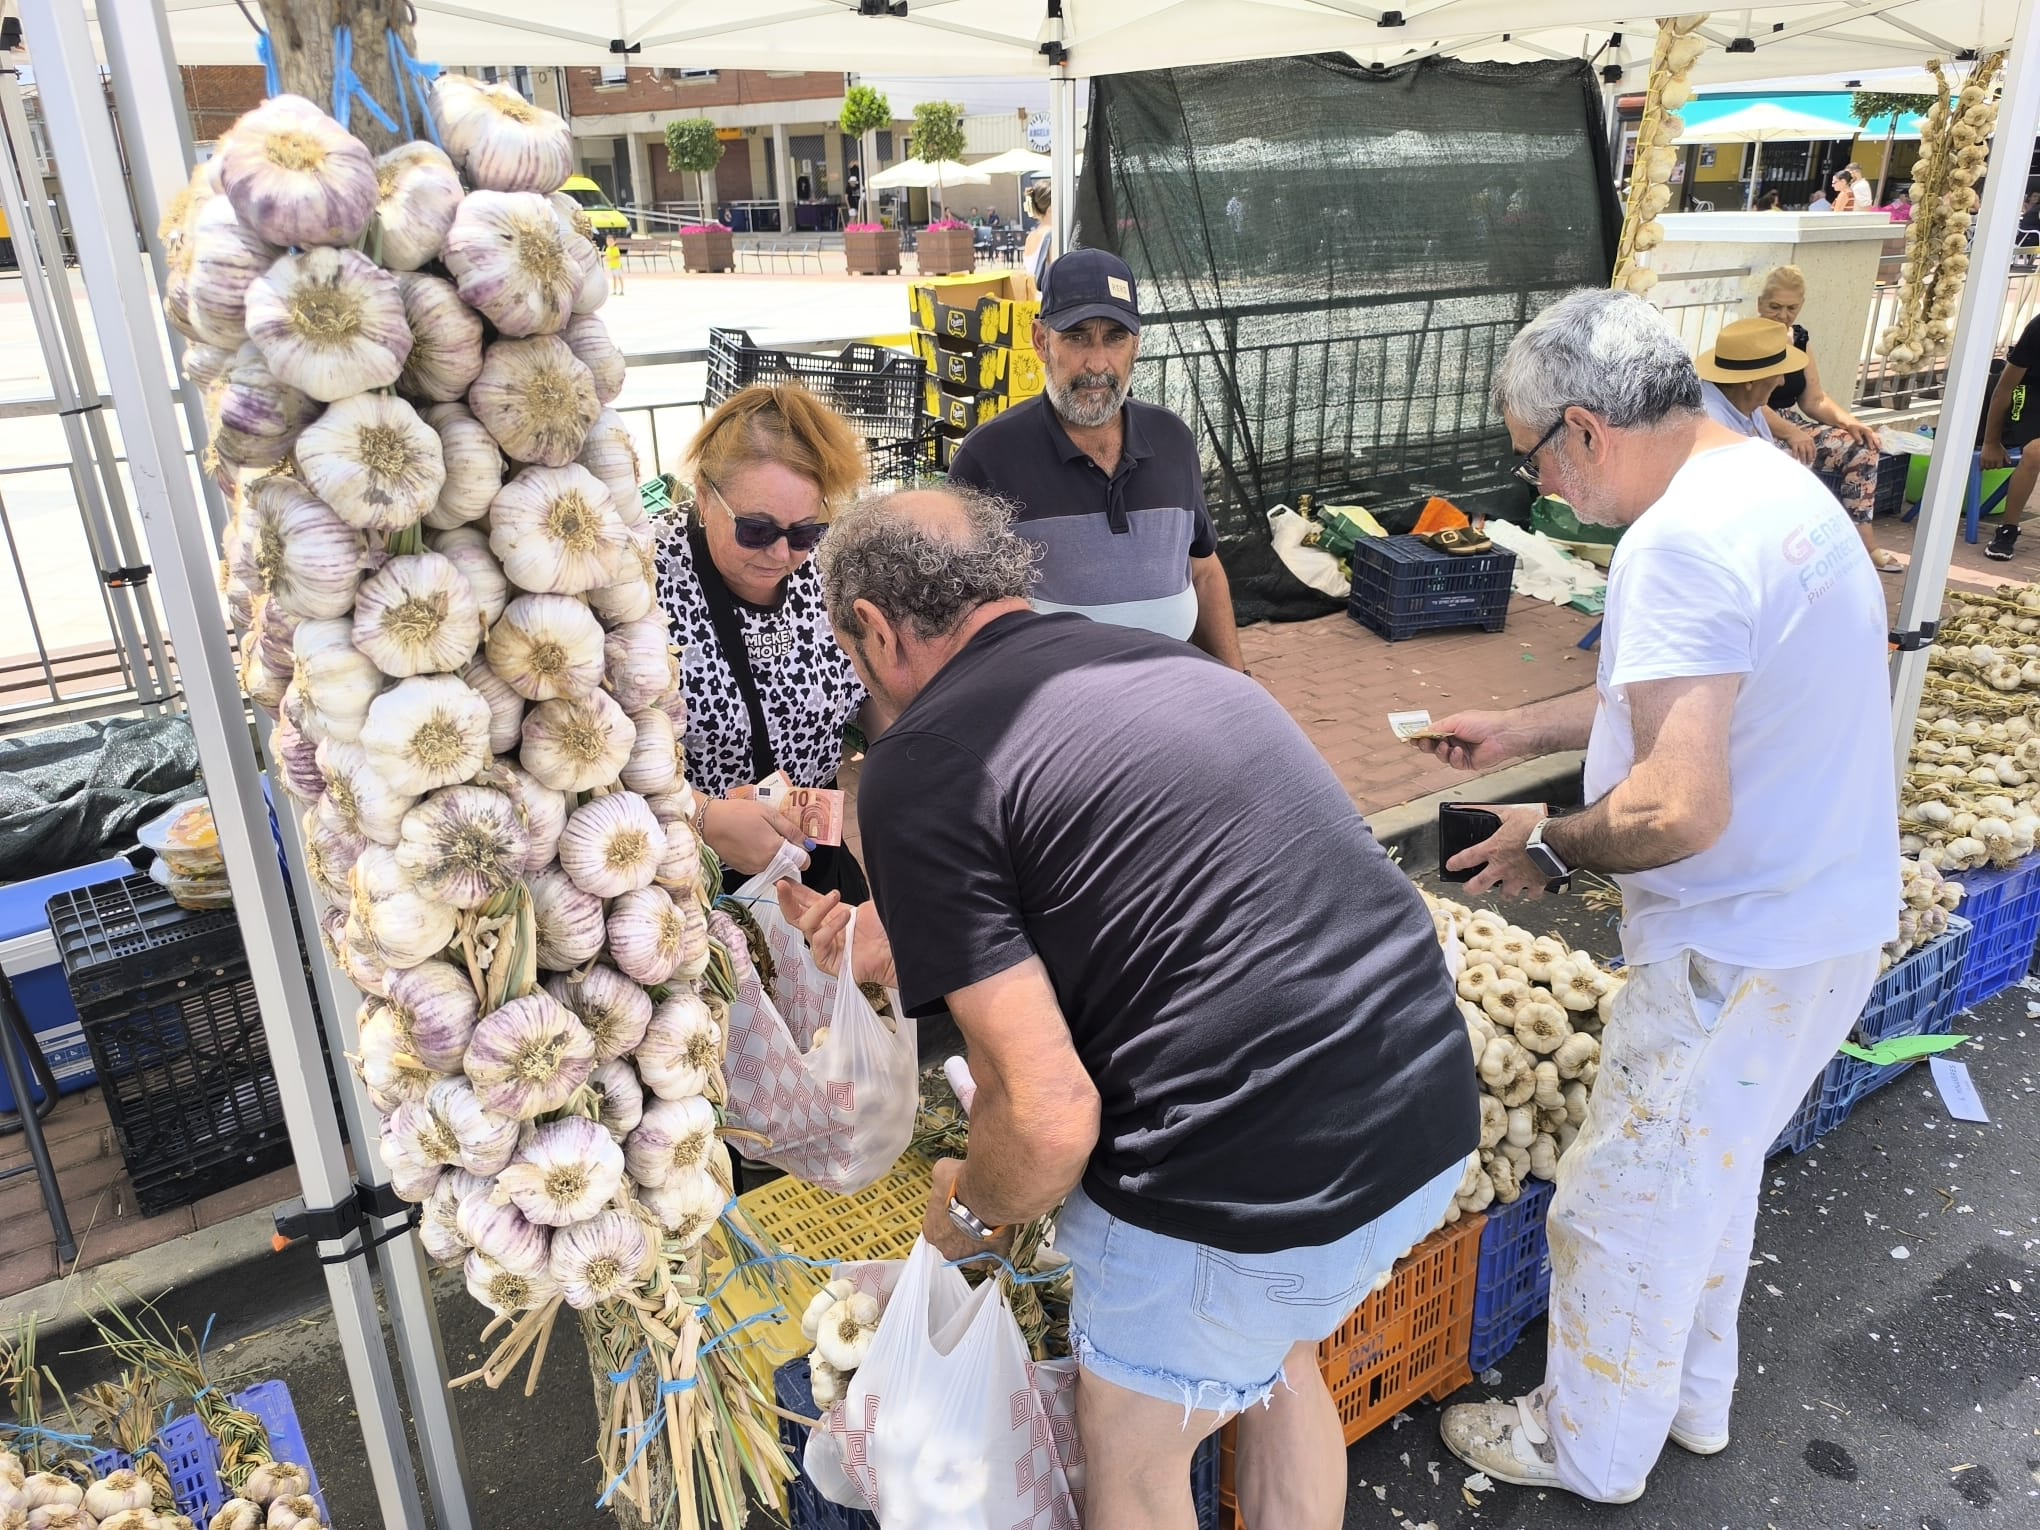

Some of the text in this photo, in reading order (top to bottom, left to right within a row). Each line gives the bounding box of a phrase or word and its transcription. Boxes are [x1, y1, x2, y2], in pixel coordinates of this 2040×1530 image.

[744, 629, 793, 647] MICKEY
[747, 641, 792, 659] MOUSE
[789, 790, 809, 808] 10
